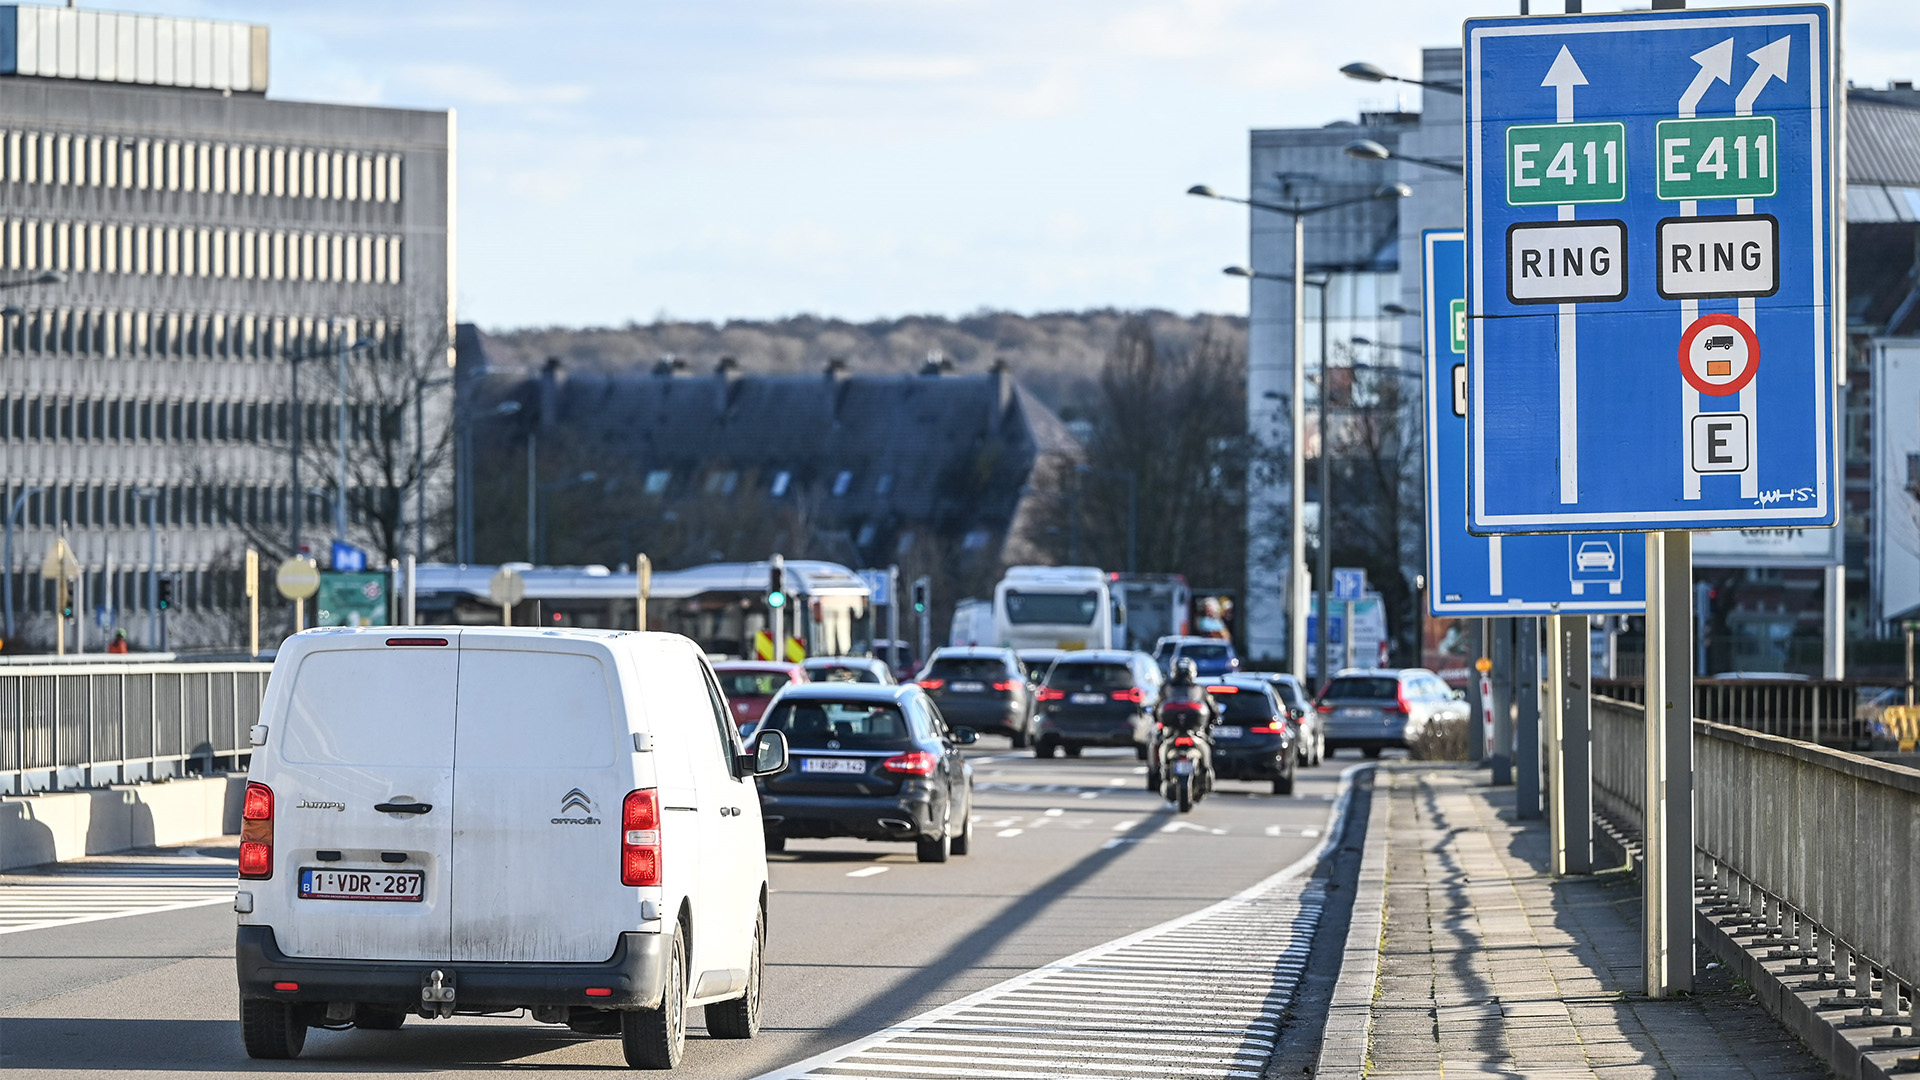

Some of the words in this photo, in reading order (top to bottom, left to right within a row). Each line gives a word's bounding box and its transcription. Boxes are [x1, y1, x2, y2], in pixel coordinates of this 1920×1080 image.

[1514, 141, 1617, 187] E411
[1664, 135, 1768, 181] E411
[1521, 246, 1610, 278] RING
[1671, 241, 1761, 273] RING
[1707, 423, 1732, 463] E
[315, 873, 419, 894] 1-VDR-287
